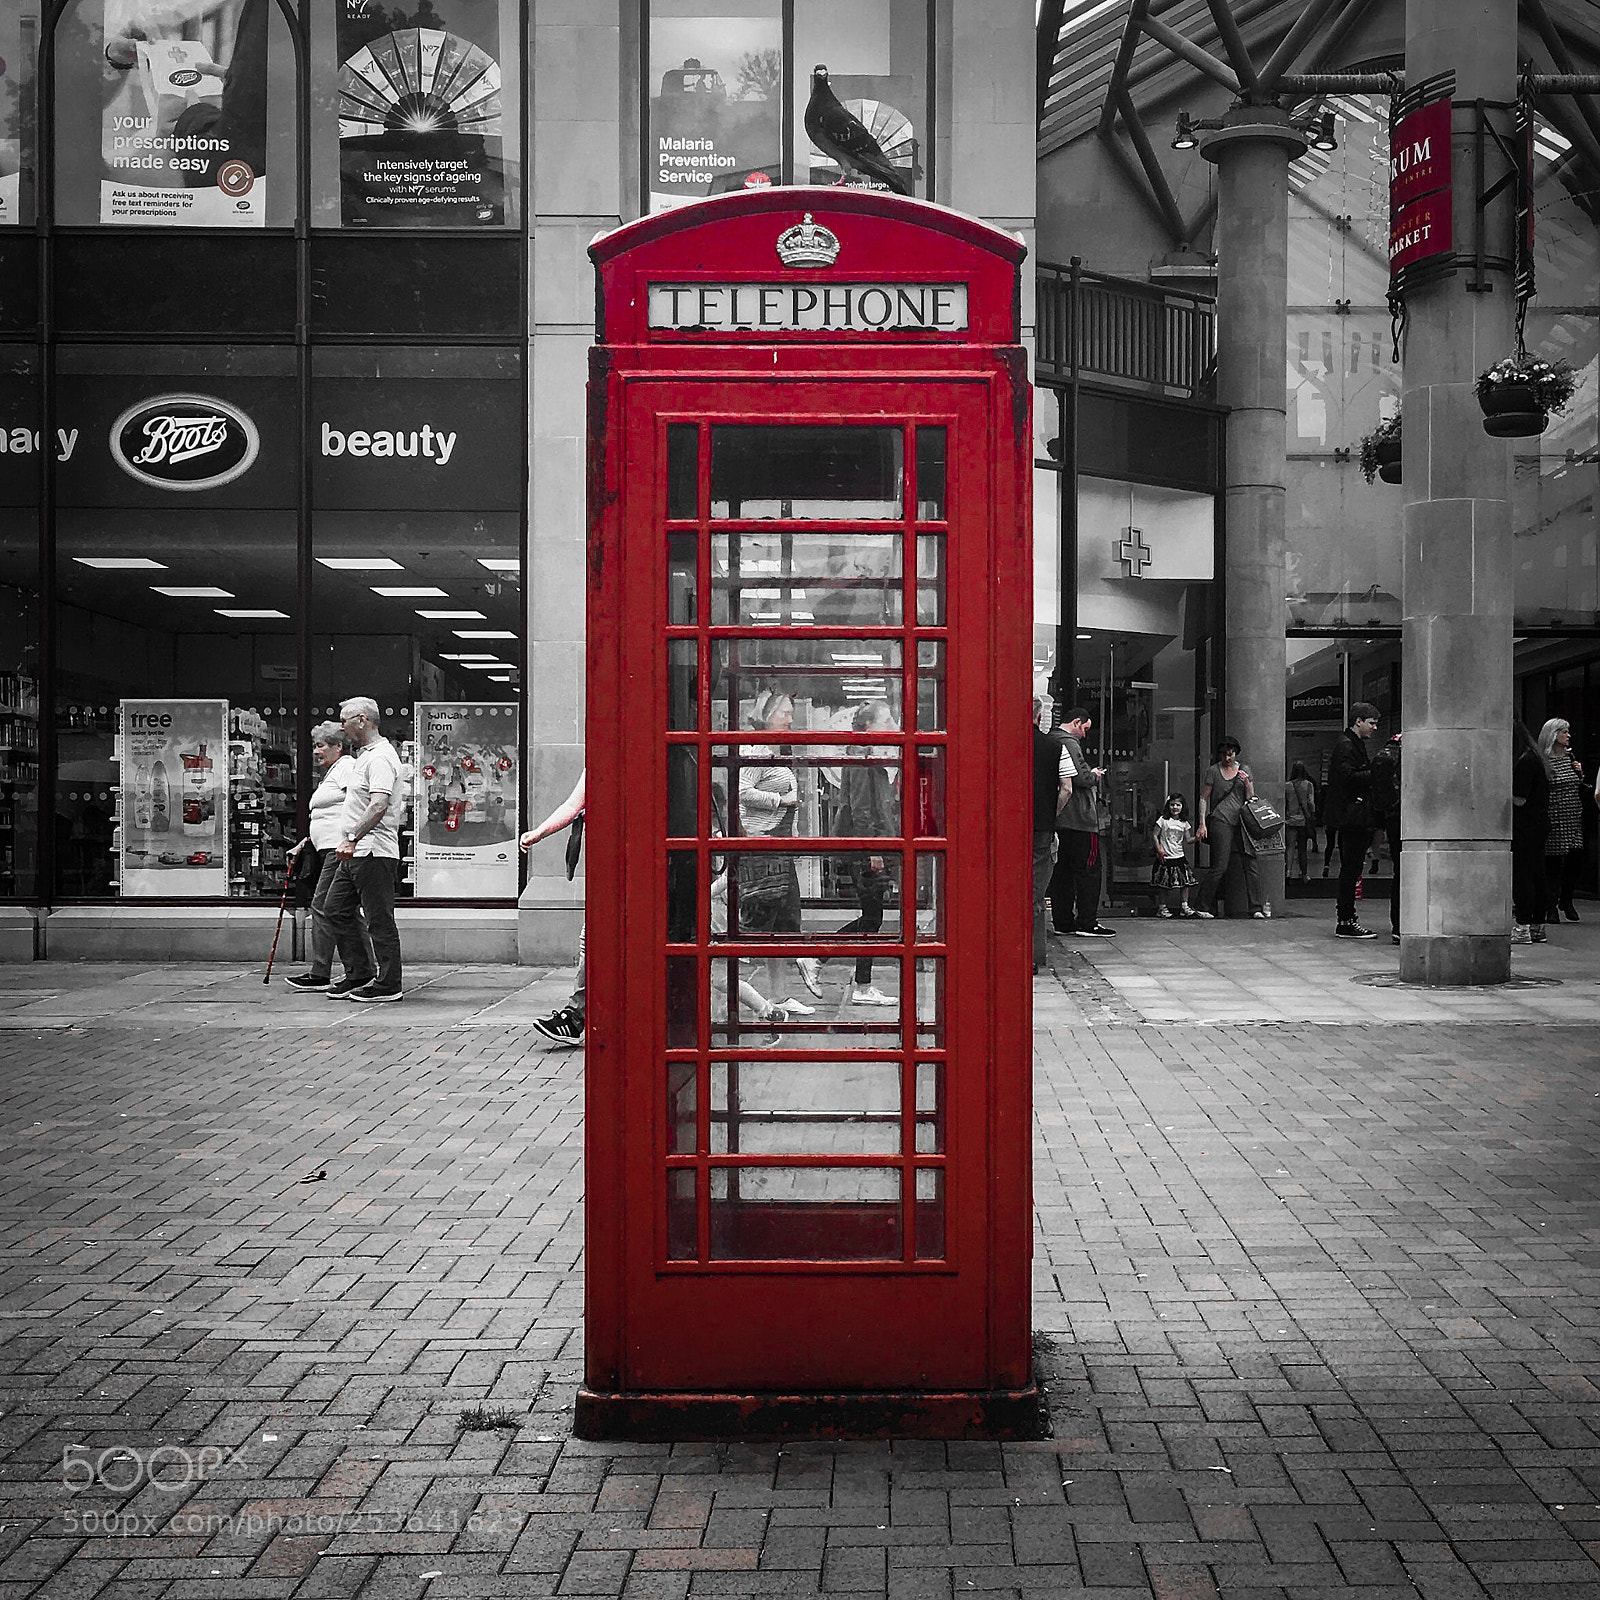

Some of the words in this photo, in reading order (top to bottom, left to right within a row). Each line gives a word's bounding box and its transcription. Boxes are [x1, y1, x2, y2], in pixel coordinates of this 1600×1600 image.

[113, 116, 152, 131] your
[113, 134, 230, 152] prescriptions
[659, 137, 714, 151] Malaria
[113, 154, 163, 169] made
[168, 158, 210, 173] easy
[376, 159, 434, 172] Intensively
[435, 159, 468, 171] target
[659, 154, 736, 167] Prevention
[363, 172, 382, 182] the
[384, 172, 403, 184] key
[404, 173, 432, 184] signs
[433, 172, 444, 182] of
[445, 172, 481, 183] ageing
[658, 169, 713, 183] Service
[112, 190, 126, 198] Ask
[138, 191, 160, 199] about
[161, 192, 194, 200] receiving
[389, 185, 407, 193] with
[143, 200, 180, 208] reminders
[365, 196, 394, 204] Clinically
[418, 196, 458, 205] age-defying
[112, 209, 128, 217] your
[129, 208, 177, 217] prescriptions
[660, 288, 957, 326] TELEPHONE
[133, 416, 228, 465] Boots
[321, 422, 457, 465] beauty
[130, 711, 173, 728] free
[427, 721, 453, 732] from
